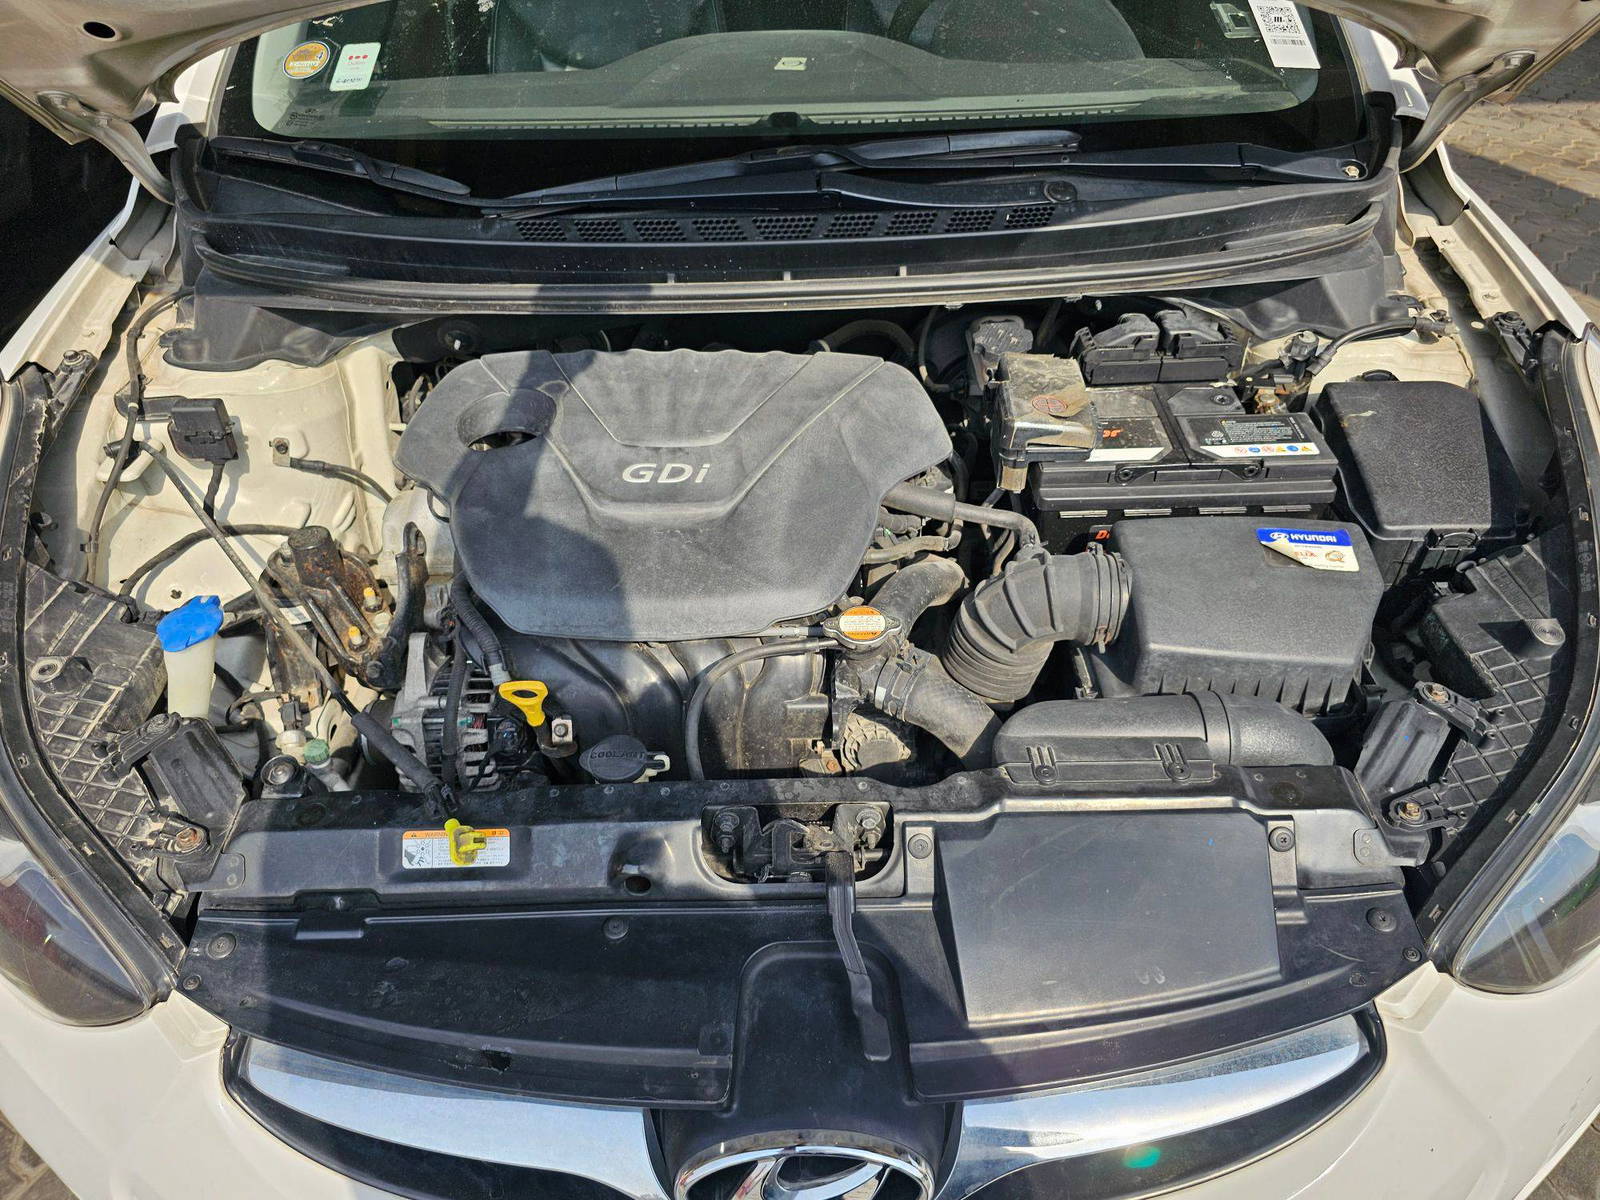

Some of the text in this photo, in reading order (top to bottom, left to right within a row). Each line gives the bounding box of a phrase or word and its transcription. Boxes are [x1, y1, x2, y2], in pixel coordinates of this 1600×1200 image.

[622, 463, 711, 483] GDi
[1290, 533, 1337, 543] HYUNDAI
[590, 750, 646, 760] COOLANT
